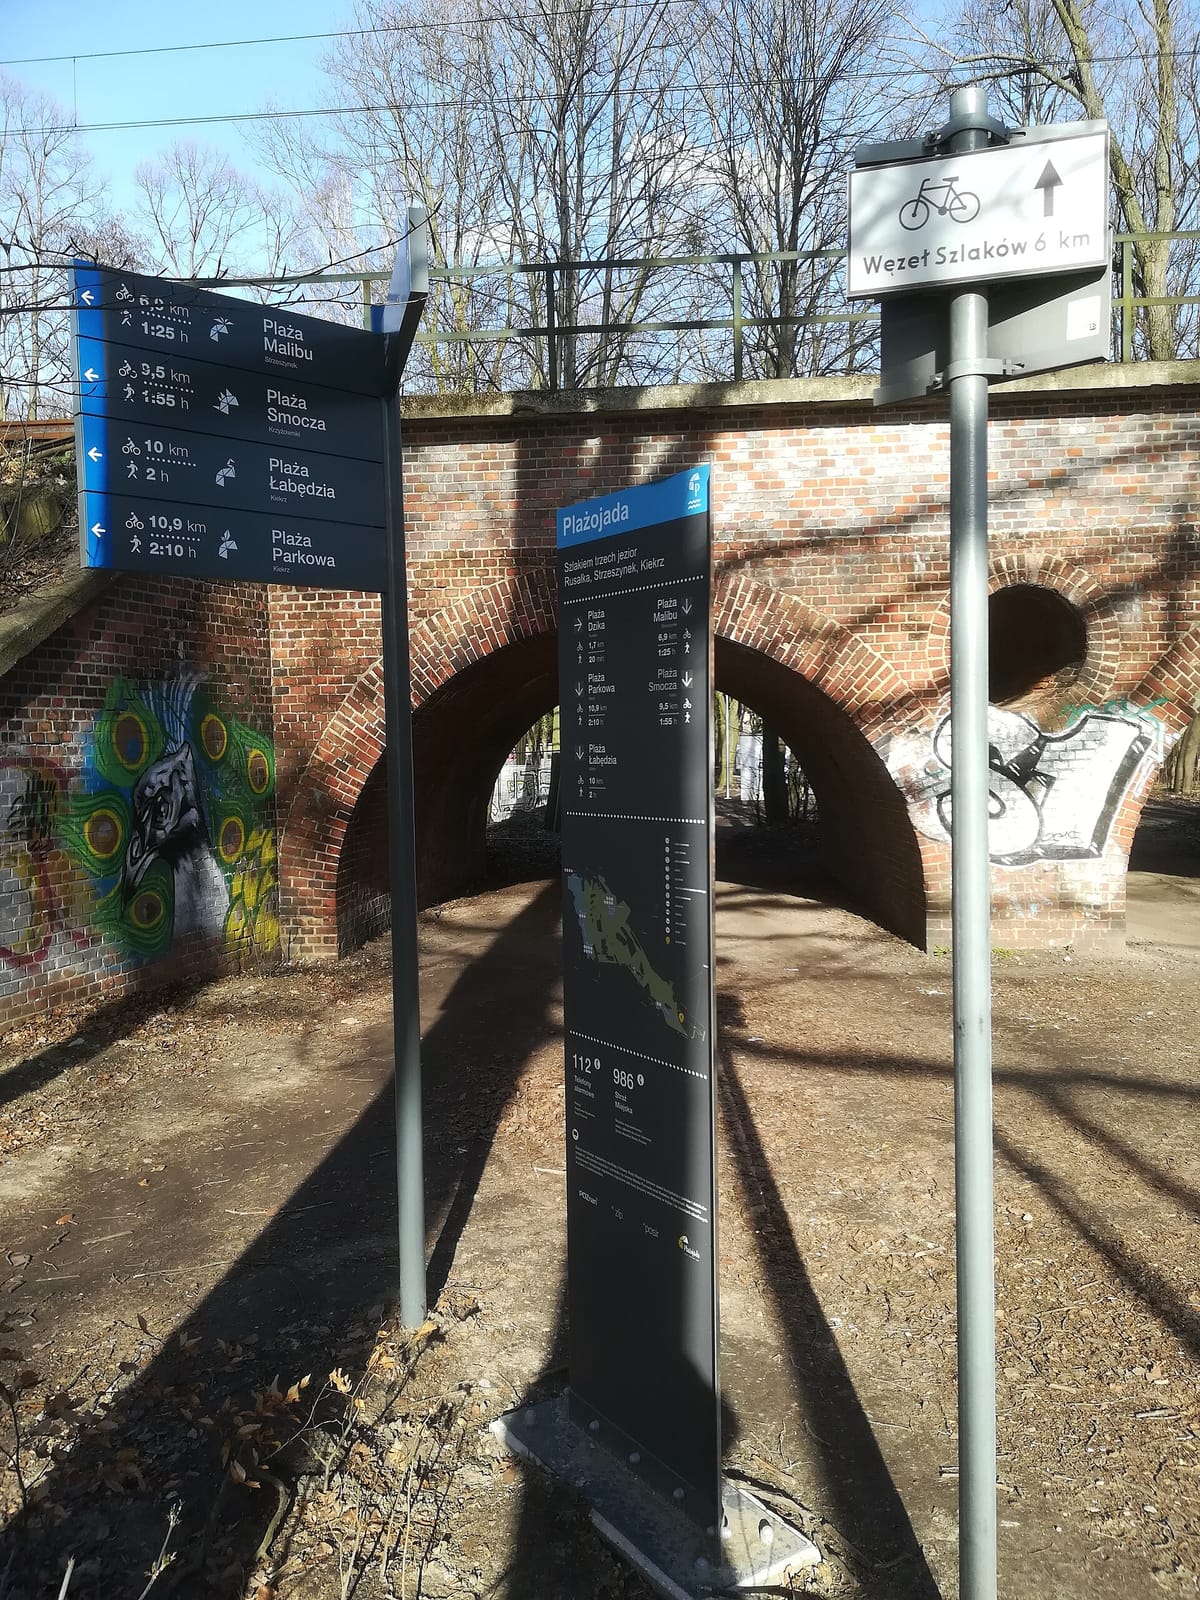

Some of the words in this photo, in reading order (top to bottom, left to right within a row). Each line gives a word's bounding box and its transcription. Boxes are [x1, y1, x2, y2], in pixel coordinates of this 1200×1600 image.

[863, 248, 930, 277] Węzeł
[934, 238, 1027, 265] Szlaków
[1034, 232, 1047, 252] 6
[1059, 230, 1090, 249] km
[169, 301, 189, 318] km
[141, 321, 175, 340] 1:25
[180, 329, 189, 343] h
[263, 318, 304, 341] Plaża
[263, 336, 313, 360] Malibu
[141, 362, 166, 380] 9,5
[170, 368, 190, 384] km
[141, 390, 176, 407] 1:55
[181, 396, 189, 410] h
[266, 388, 308, 410] Plaża
[267, 407, 327, 431] Smocza
[144, 439, 164, 454] 10
[168, 442, 189, 458] km
[146, 467, 156, 481] 2
[160, 469, 169, 483] h
[269, 457, 310, 478] Plaża
[269, 475, 336, 499] Łabędzia
[149, 515, 183, 532] 10,9
[187, 519, 207, 533] km
[562, 502, 630, 537] Plażojada
[271, 529, 312, 548] Plaża
[149, 541, 184, 557] 2:10
[188, 545, 197, 559] h
[272, 547, 336, 567] Parkowa
[563, 558, 594, 573] Szlakiem
[594, 551, 616, 565] trzech
[617, 547, 638, 564] jezior
[593, 561, 639, 581] Strzeszynek,
[640, 557, 665, 571] Kiekrz
[657, 597, 678, 609] Plaża
[587, 609, 605, 620] Plaża
[588, 672, 605, 683] Plaża
[657, 667, 678, 679] Plaża
[648, 681, 678, 692] Smocza
[588, 743, 606, 753] Plaża
[572, 1053, 592, 1074] 112
[613, 1068, 634, 1090] 986
